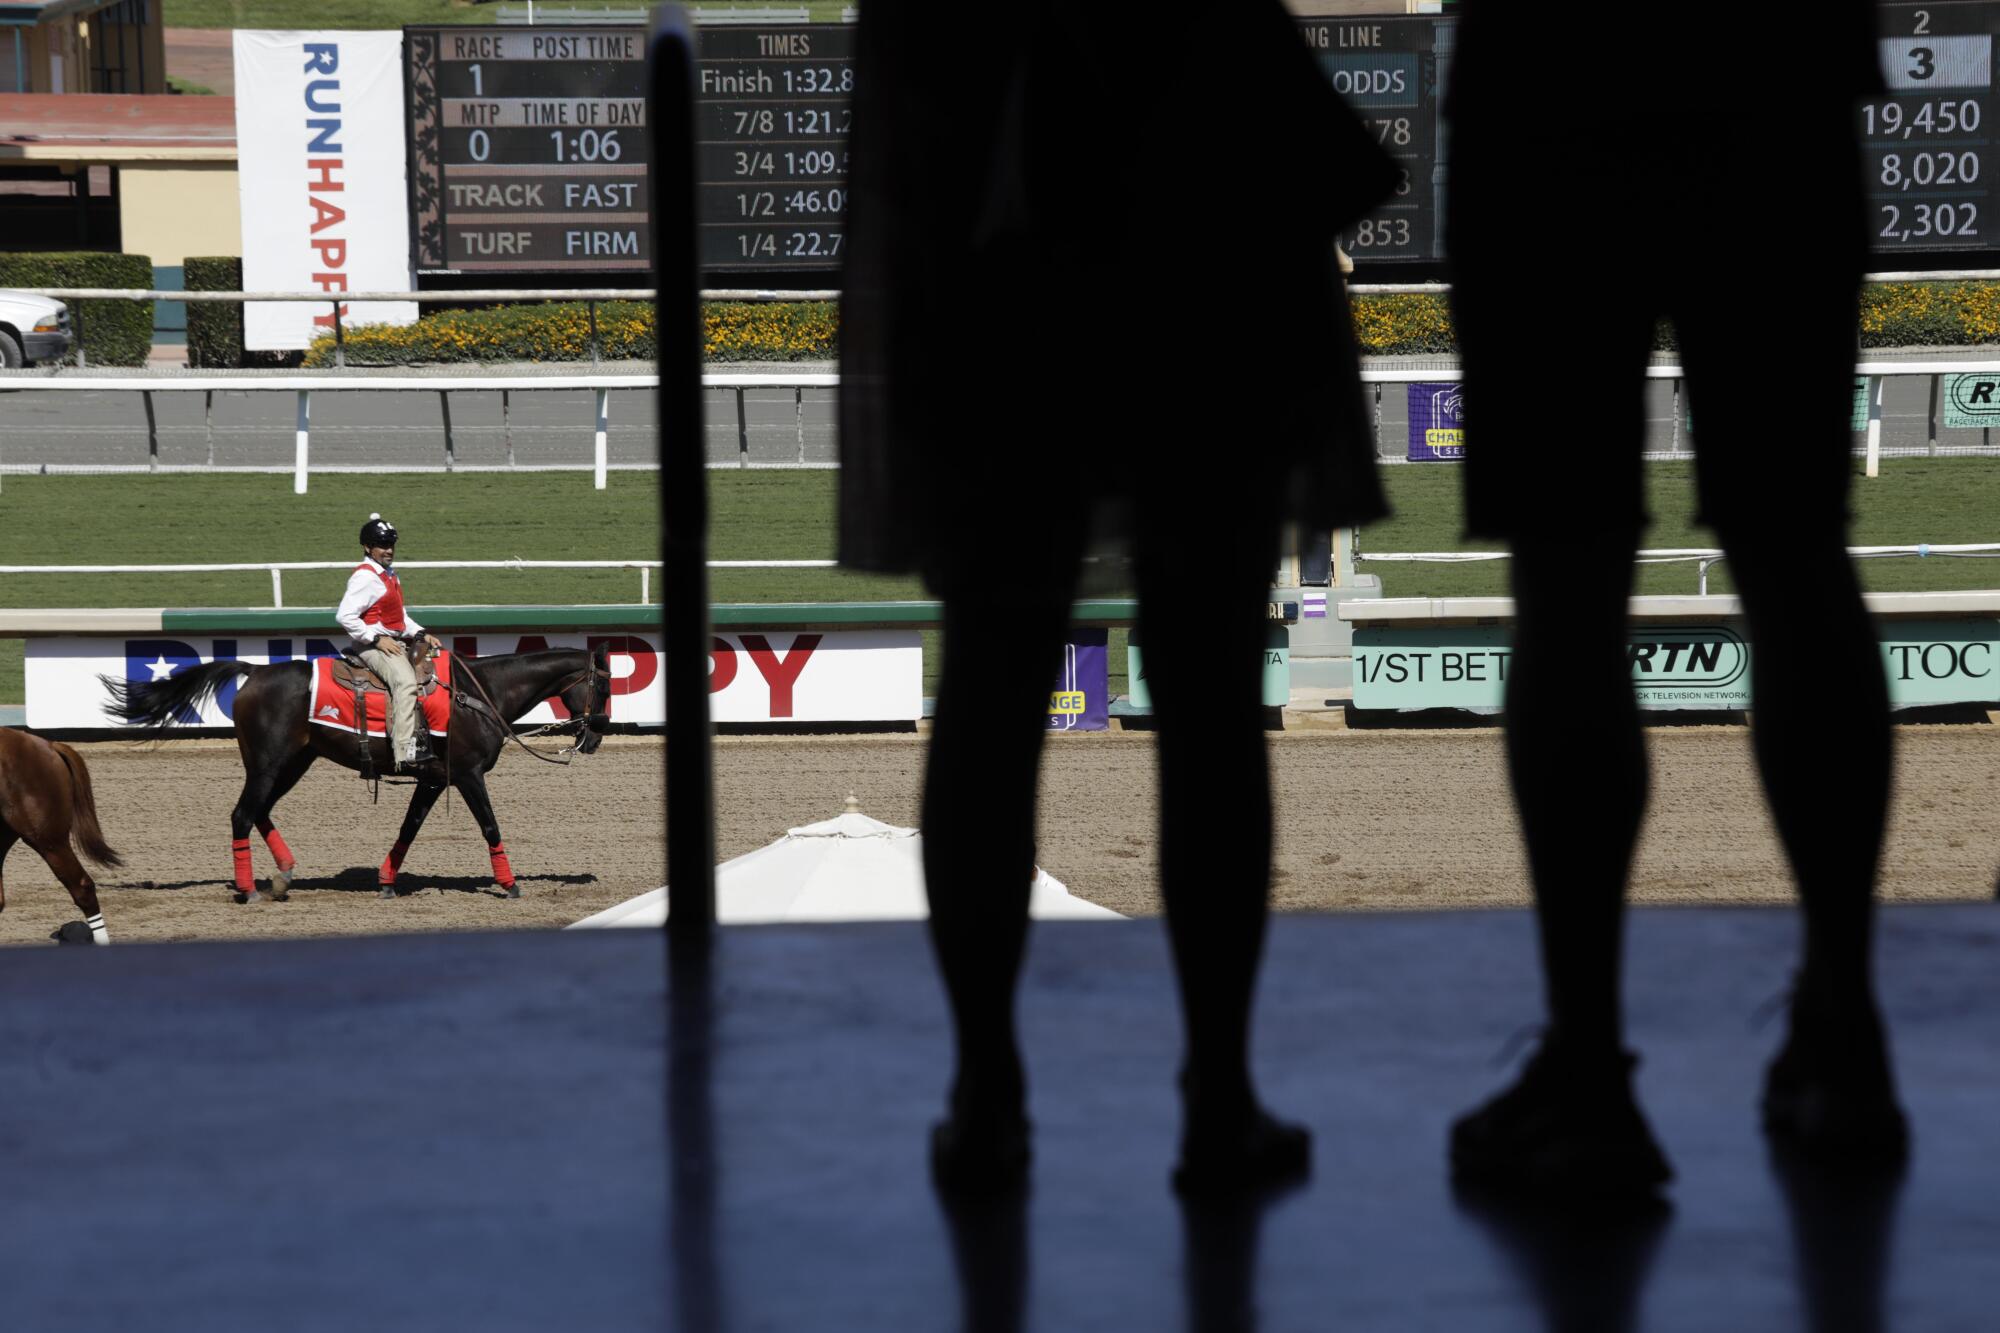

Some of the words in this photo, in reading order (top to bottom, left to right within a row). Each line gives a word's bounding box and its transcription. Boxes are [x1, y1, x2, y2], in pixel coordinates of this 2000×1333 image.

[1913, 10, 1930, 34] 2
[455, 37, 504, 58] RACE
[533, 37, 579, 58] POST
[587, 37, 633, 58] TIME
[758, 34, 810, 55] TIMES
[1303, 26, 1329, 48] NG
[1339, 26, 1382, 47] LINE
[1908, 47, 1934, 80] 3
[469, 64, 482, 96] 1
[701, 68, 772, 93] Finish
[1333, 69, 1405, 94] ODDS
[461, 103, 499, 124] MTP
[522, 103, 568, 124] TIME
[576, 103, 599, 123] OF
[608, 103, 642, 123] DAY
[734, 110, 774, 135] 7/8
[1862, 100, 1980, 139] 19,450
[1375, 118, 1411, 145] 78
[469, 129, 490, 161] 0
[551, 129, 621, 161] 1:06
[735, 151, 775, 176] 3/4
[1881, 152, 1979, 191] 8,020
[449, 184, 544, 206] TRACK
[565, 183, 638, 207] FAST
[737, 192, 775, 217] 1/2
[1880, 202, 1978, 241] 2,302
[460, 232, 532, 254] TURF
[566, 231, 638, 255] FIRM
[738, 233, 776, 258] 1/4
[1969, 382, 2000, 403] R
[1356, 653, 1432, 683] 1/ST
[1442, 652, 1514, 681] BET
[1628, 642, 1723, 672] RTN
[1889, 642, 1991, 680] TOC
[1652, 691, 1702, 700] TELEVISION
